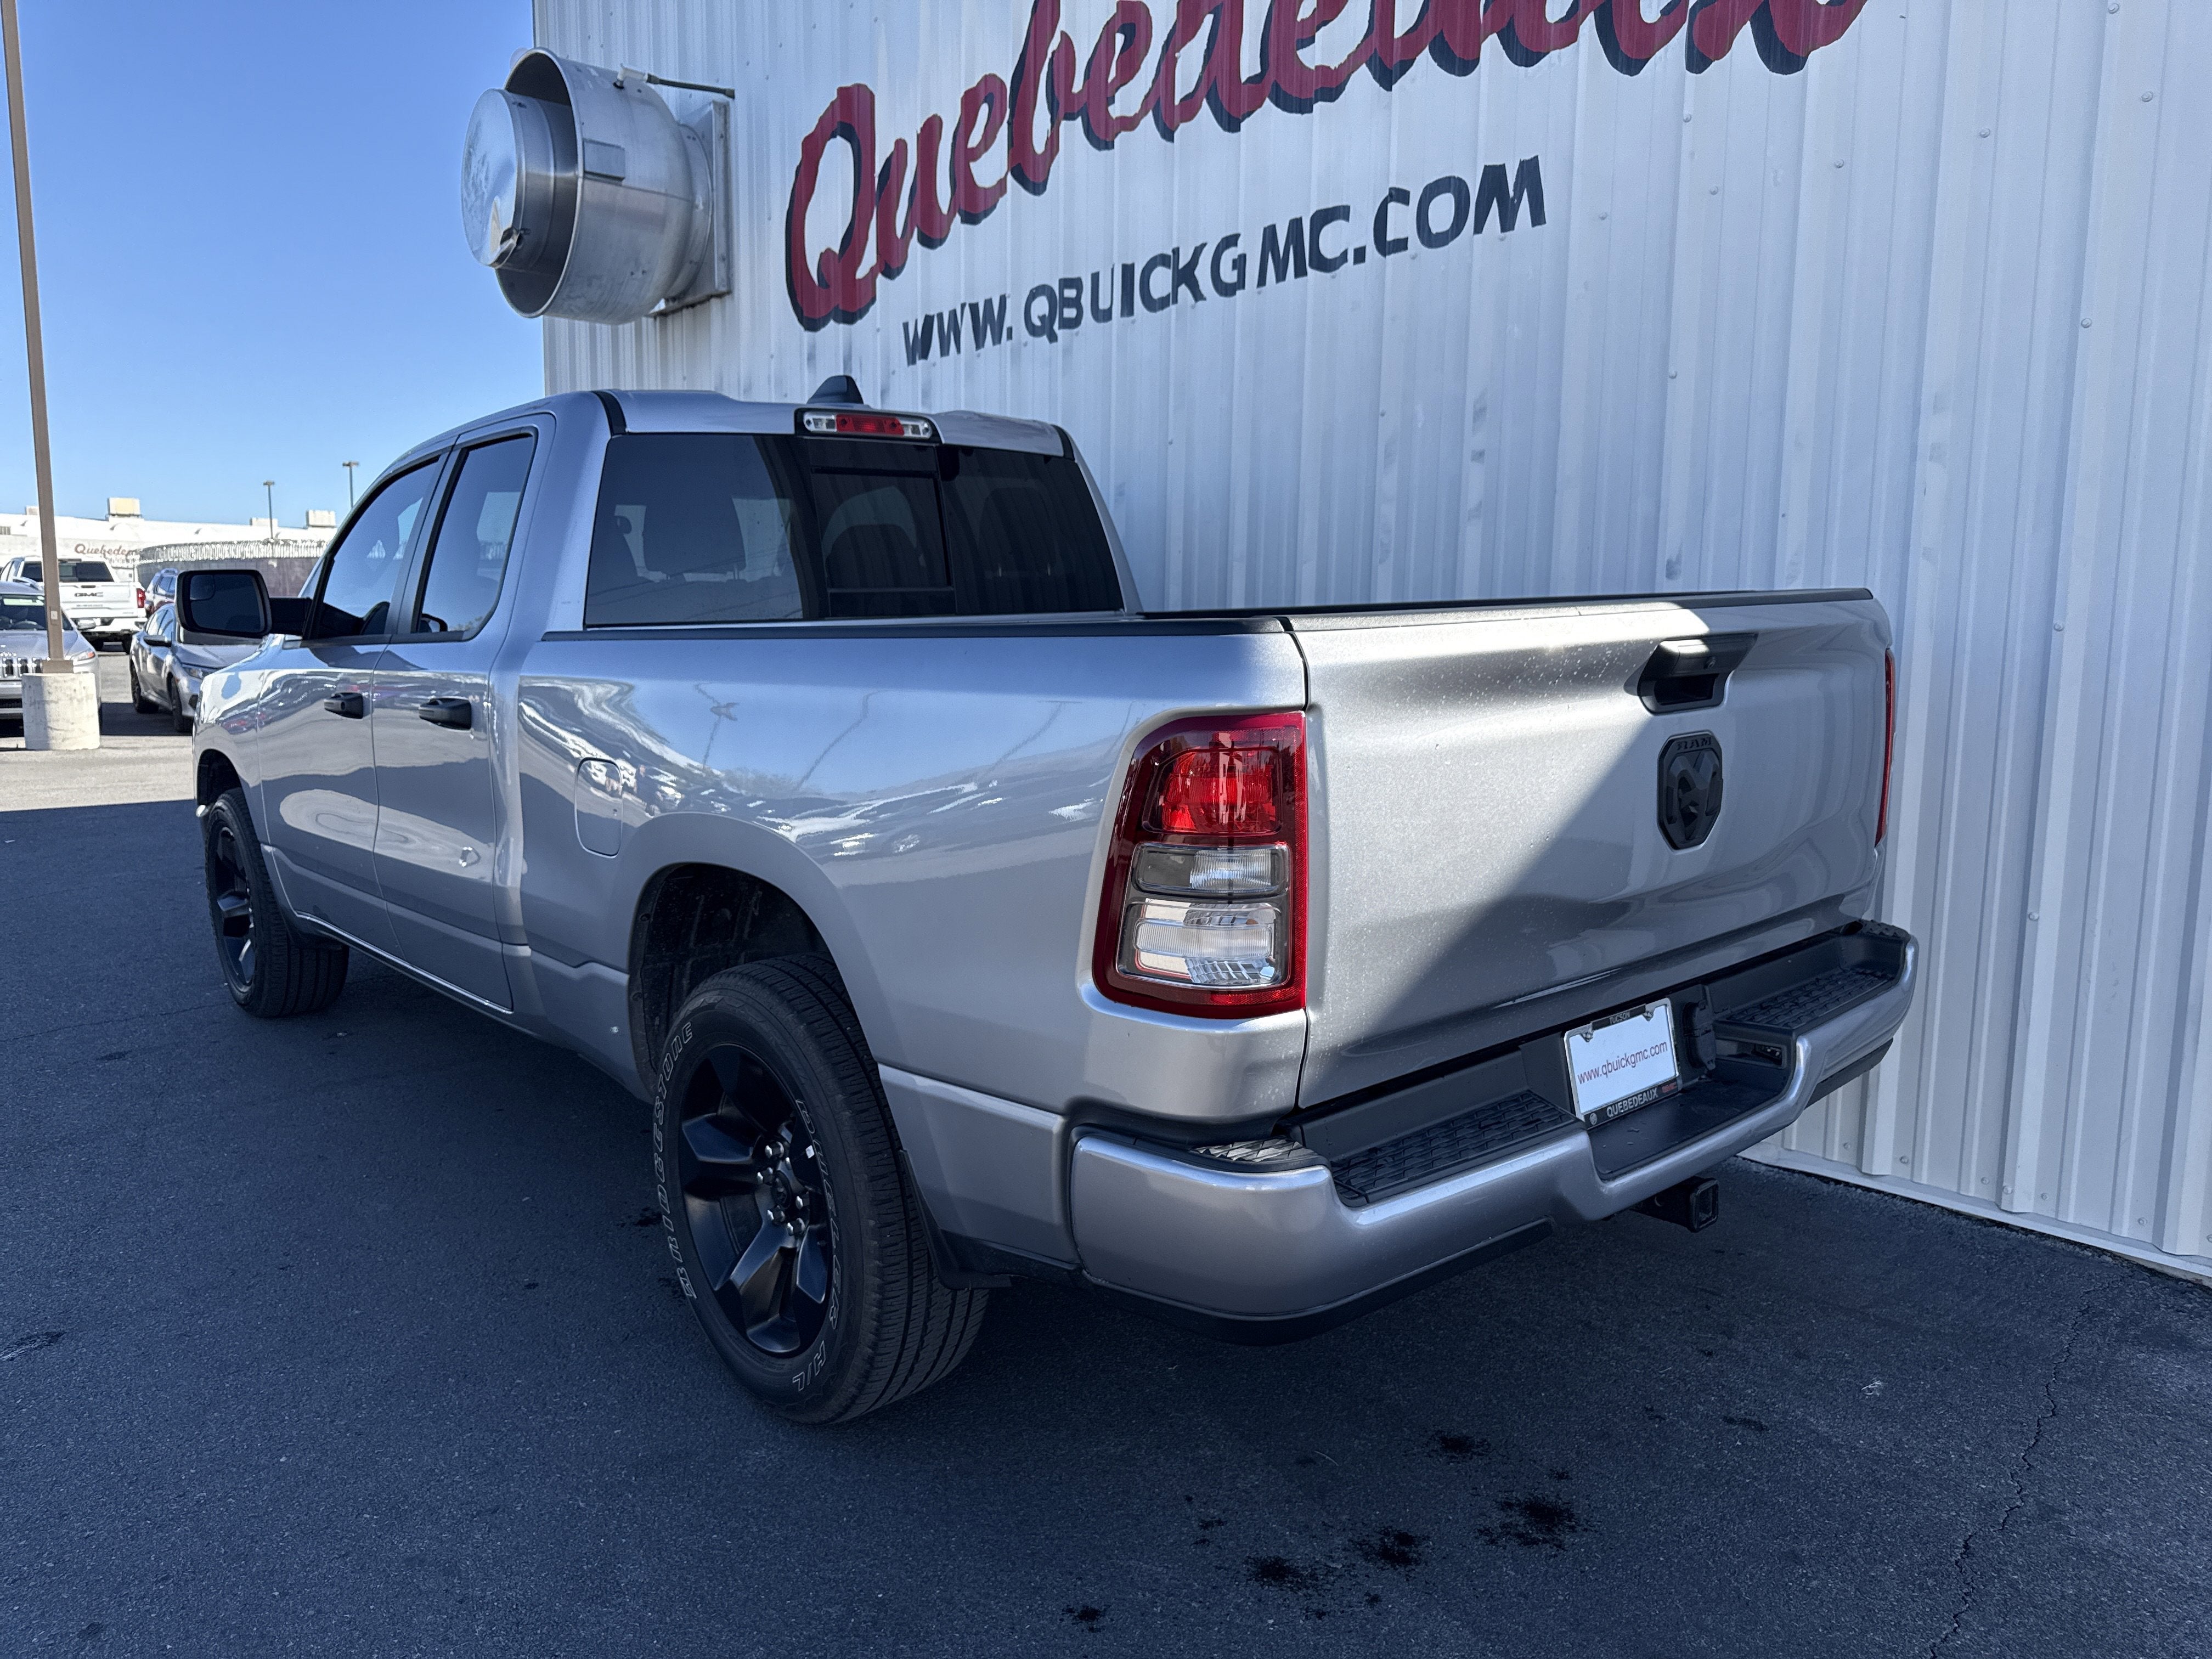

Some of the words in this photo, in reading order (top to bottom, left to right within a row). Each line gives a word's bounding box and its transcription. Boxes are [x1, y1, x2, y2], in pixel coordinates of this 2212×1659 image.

[74, 543, 137, 556] Quebede
[1678, 737, 1711, 750] RAM
[1609, 1011, 1630, 1024] TUCSON
[1577, 1041, 1668, 1085] www.qbuickgmc.com
[1606, 1088, 1658, 1118] QUEBEDEAUX
[653, 1021, 697, 1299] BRIDGESTONE
